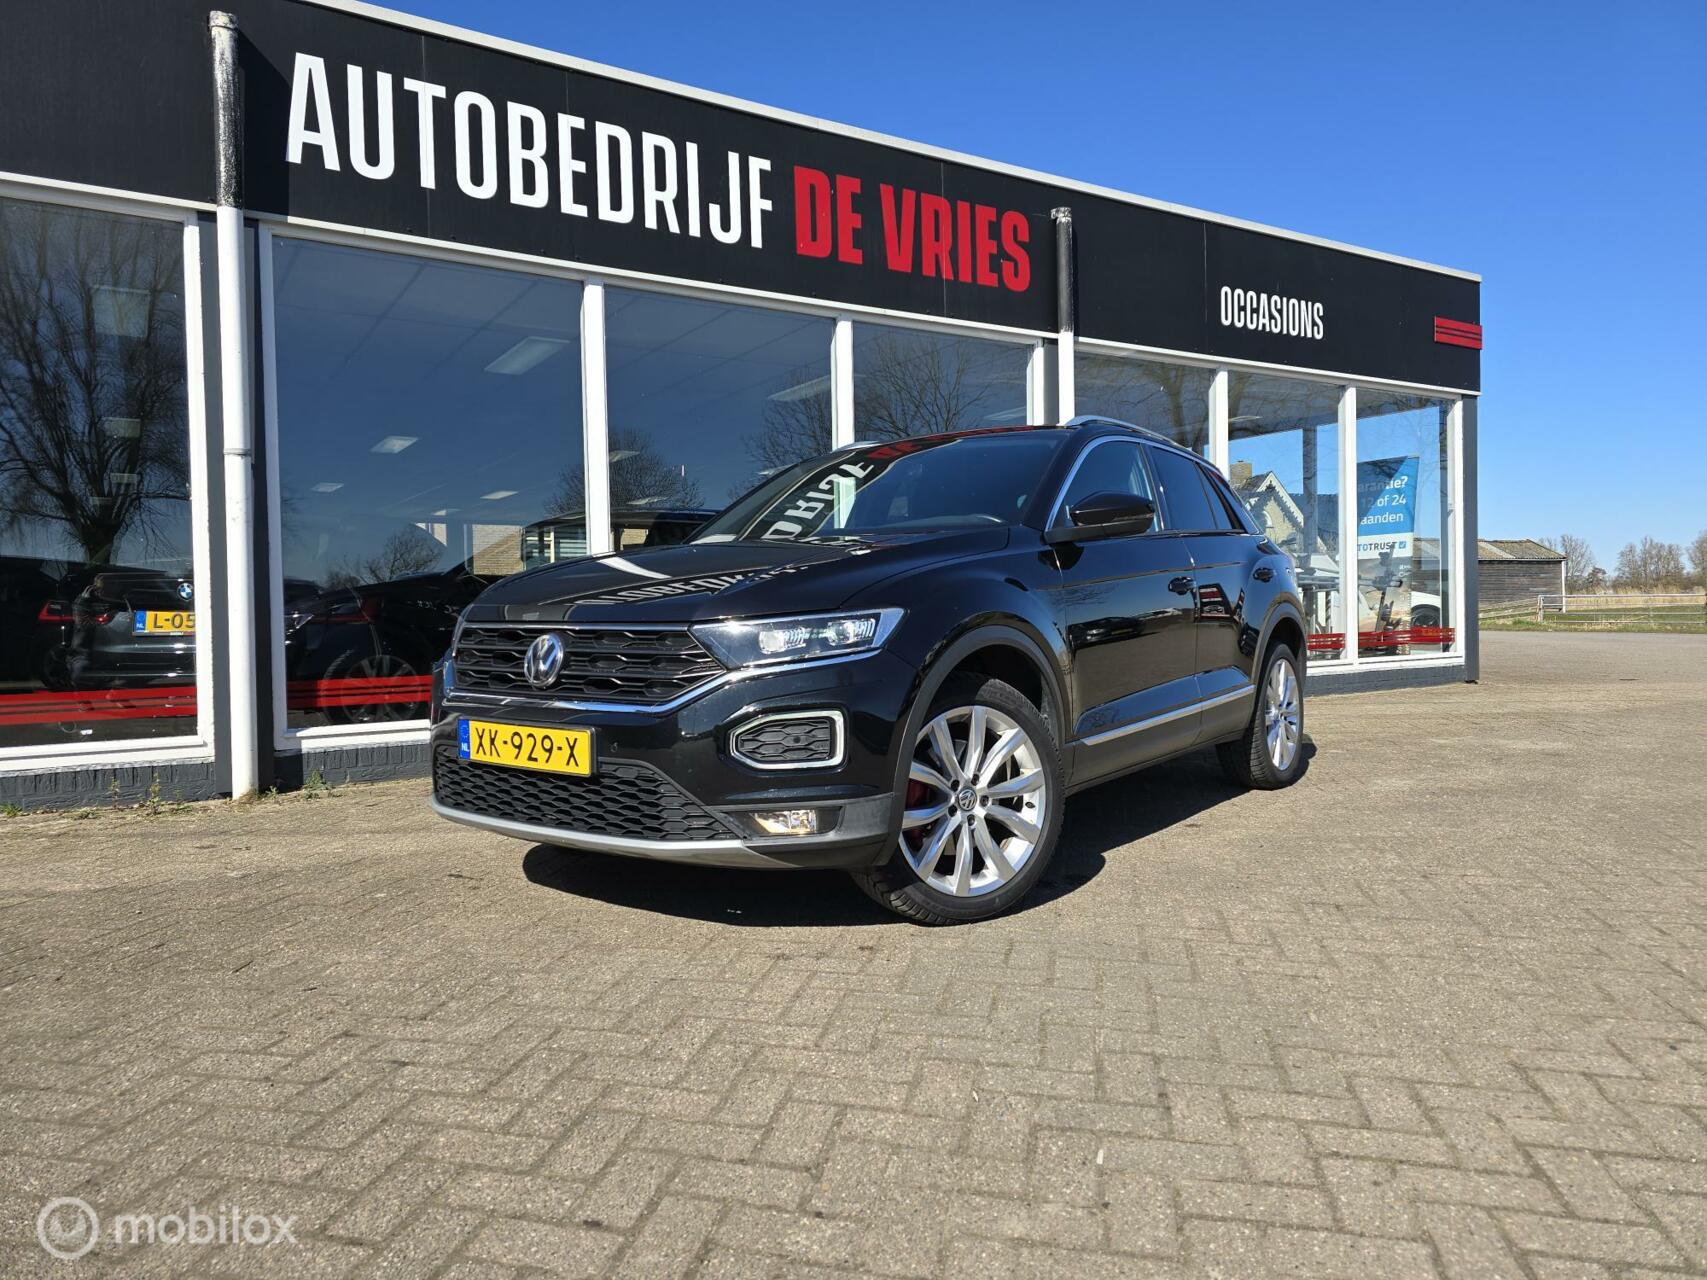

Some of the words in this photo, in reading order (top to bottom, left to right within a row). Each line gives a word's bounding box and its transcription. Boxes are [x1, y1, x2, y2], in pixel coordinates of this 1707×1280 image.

[286, 52, 773, 249] AUTOBEDRIJF
[793, 165, 863, 265] DE
[879, 183, 1031, 292] VRIES
[1220, 285, 1324, 340] OCCASIONS
[1377, 496, 1389, 507] of
[1391, 494, 1407, 506] 24
[1360, 512, 1404, 524] aanden
[1357, 541, 1398, 552] TOTRUST
[153, 613, 195, 629] L-05
[461, 742, 470, 752] NL
[474, 727, 579, 767] XK-929-X
